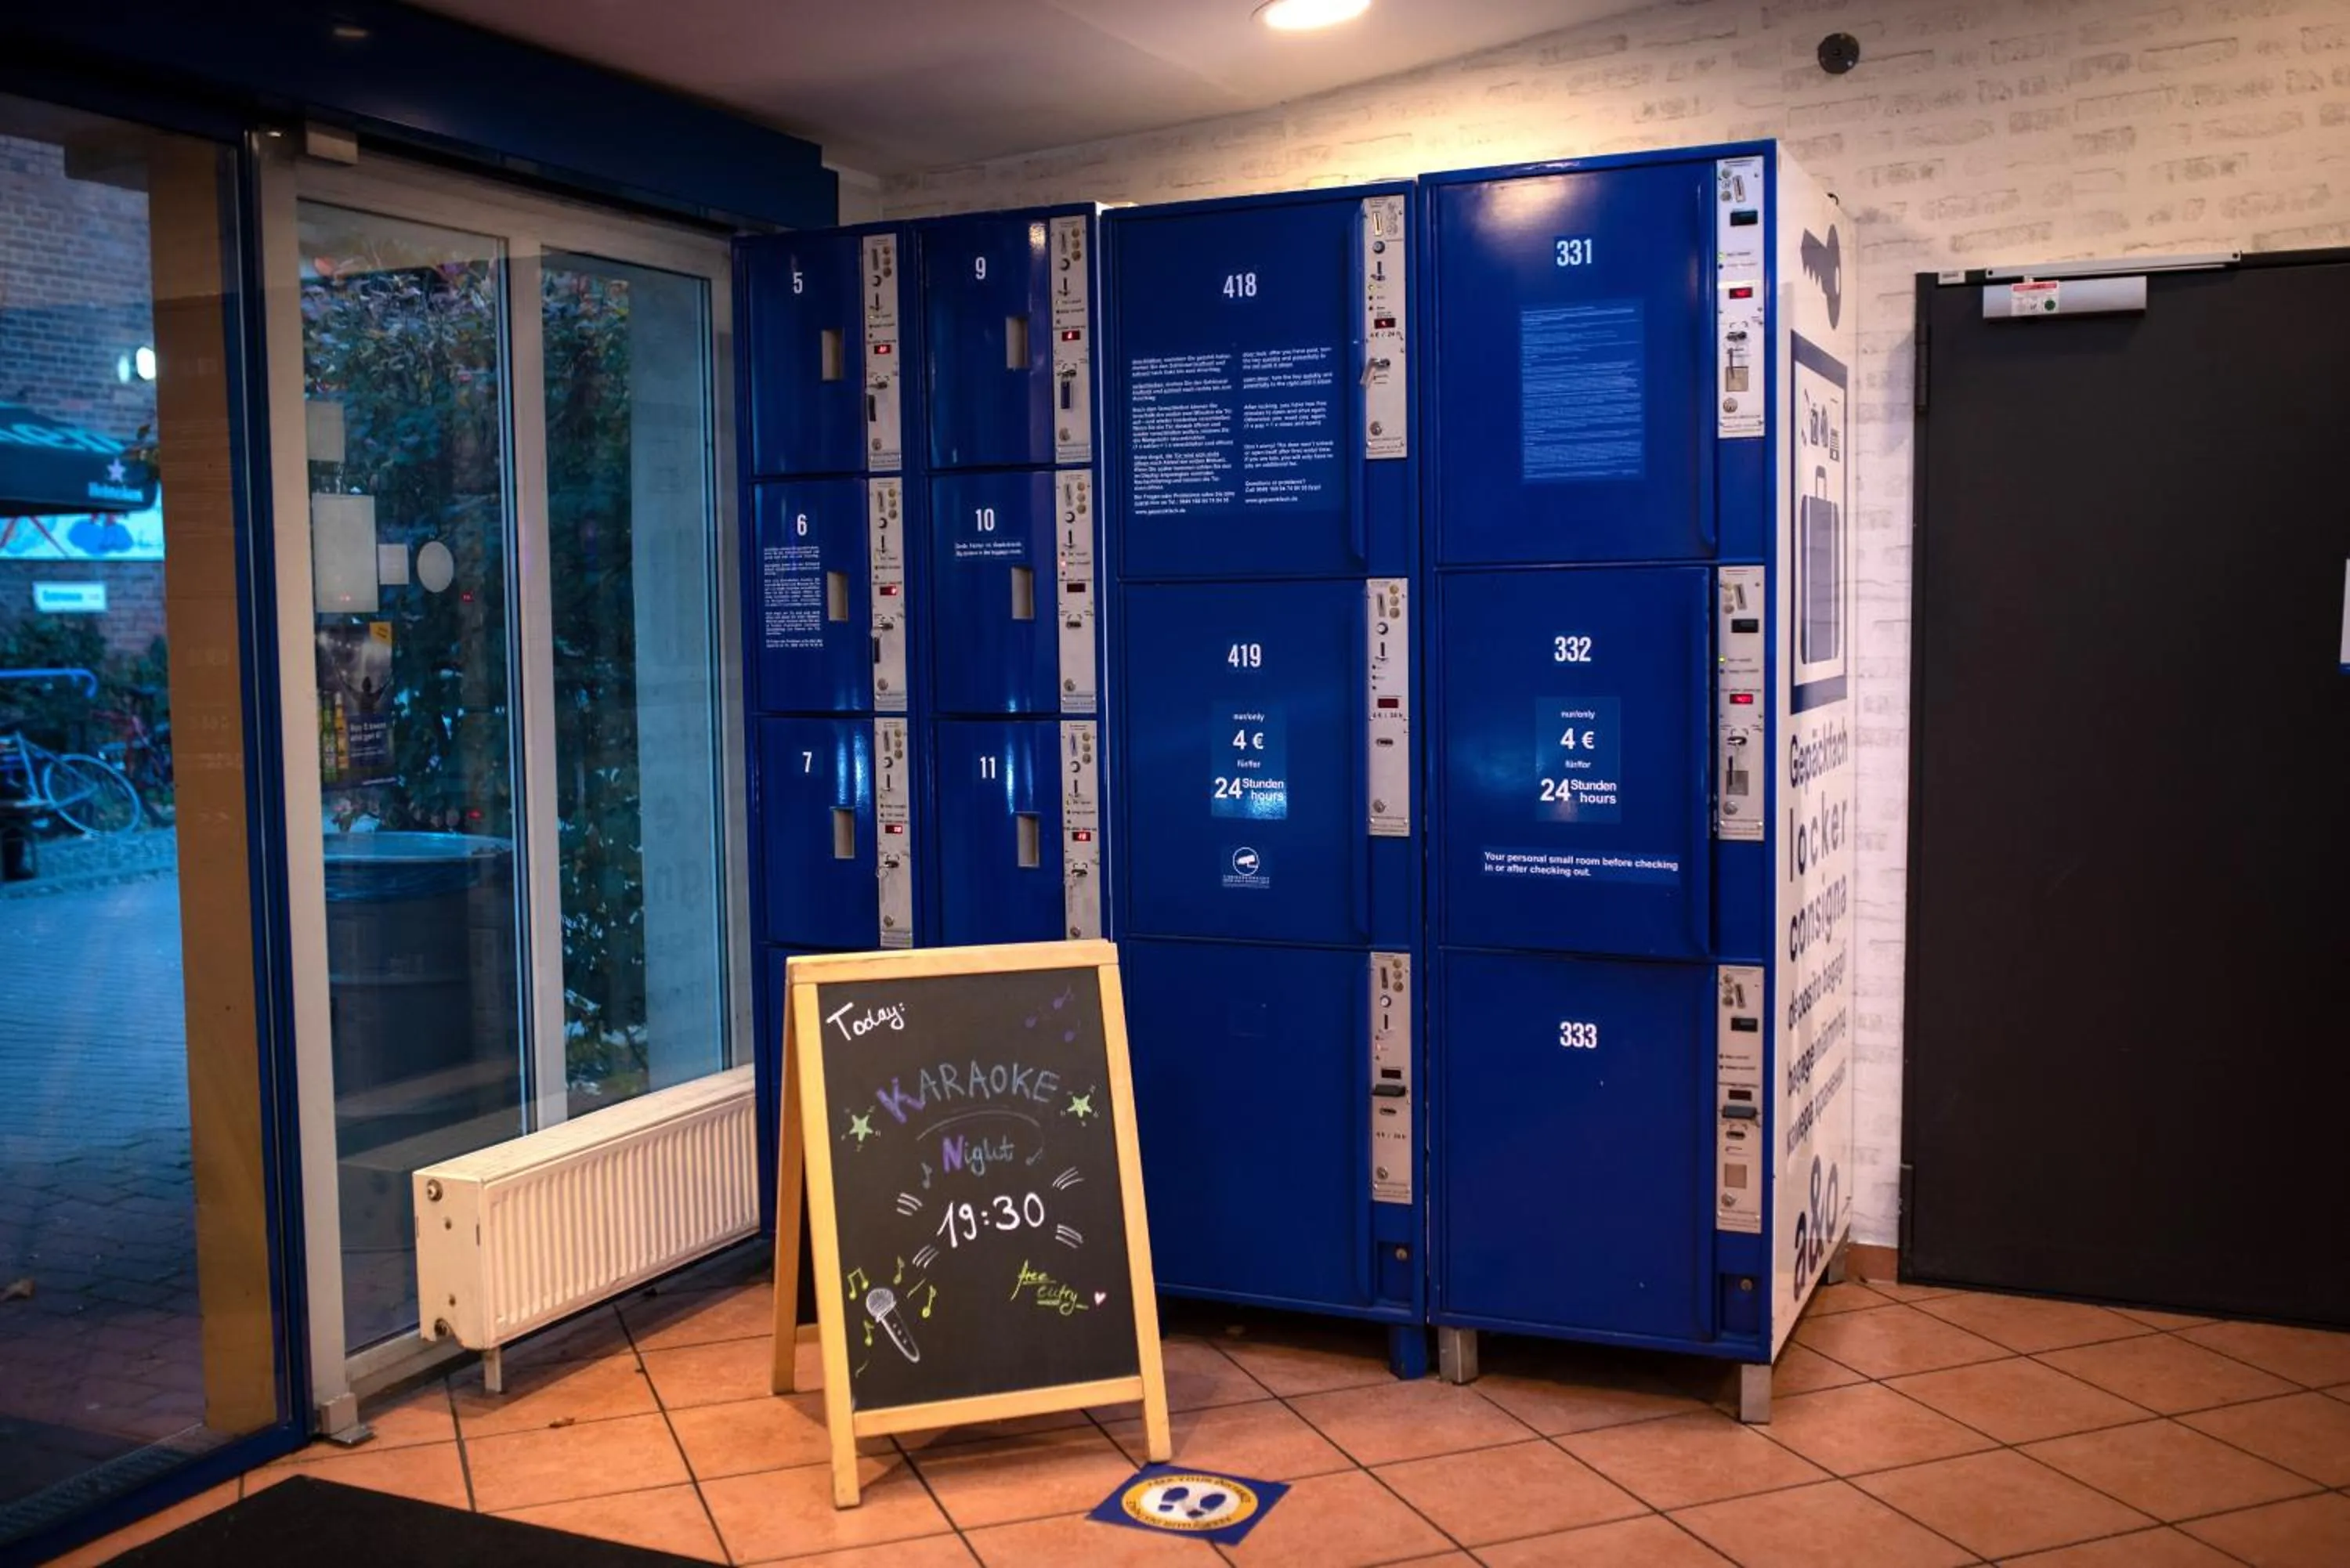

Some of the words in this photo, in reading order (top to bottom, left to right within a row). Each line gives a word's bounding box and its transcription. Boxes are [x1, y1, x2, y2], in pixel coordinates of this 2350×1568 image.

[1556, 239, 1592, 267] 331
[975, 256, 987, 280] 9
[794, 272, 804, 294] 5
[1223, 272, 1257, 298] 418
[797, 512, 808, 536] 6
[975, 508, 995, 532] 10
[1227, 643, 1262, 668] 419
[1554, 636, 1592, 663] 332
[1232, 729, 1247, 750] 4
[1253, 732, 1264, 750] €
[1560, 728, 1575, 750] 4
[1582, 731, 1595, 750] €
[802, 751, 812, 773] 7
[1789, 716, 1848, 793] Gepäckfach
[980, 756, 996, 779] 11
[1215, 777, 1242, 800] 24
[1242, 778, 1285, 789] Stunden
[1251, 790, 1285, 801] hours
[1540, 778, 1571, 801] 24
[1571, 779, 1617, 791] Stunden
[1580, 793, 1617, 804] hours
[1789, 790, 1847, 883] locker
[1484, 851, 1505, 862] Your
[1507, 854, 1547, 865] personal
[1549, 855, 1574, 865] small
[1602, 857, 1633, 867] before
[1635, 858, 1679, 871] checking
[1507, 864, 1527, 873] after
[1529, 865, 1571, 877] checking
[1790, 873, 1847, 963] consigna
[825, 999, 906, 1042] Today:
[1560, 1021, 1597, 1049] 333
[876, 1059, 1061, 1125] KARAOKE
[941, 1133, 1017, 1178] Night
[937, 1190, 1046, 1248] 19:30
[1794, 1154, 1839, 1302] a&o
[1010, 1258, 1055, 1302] free
